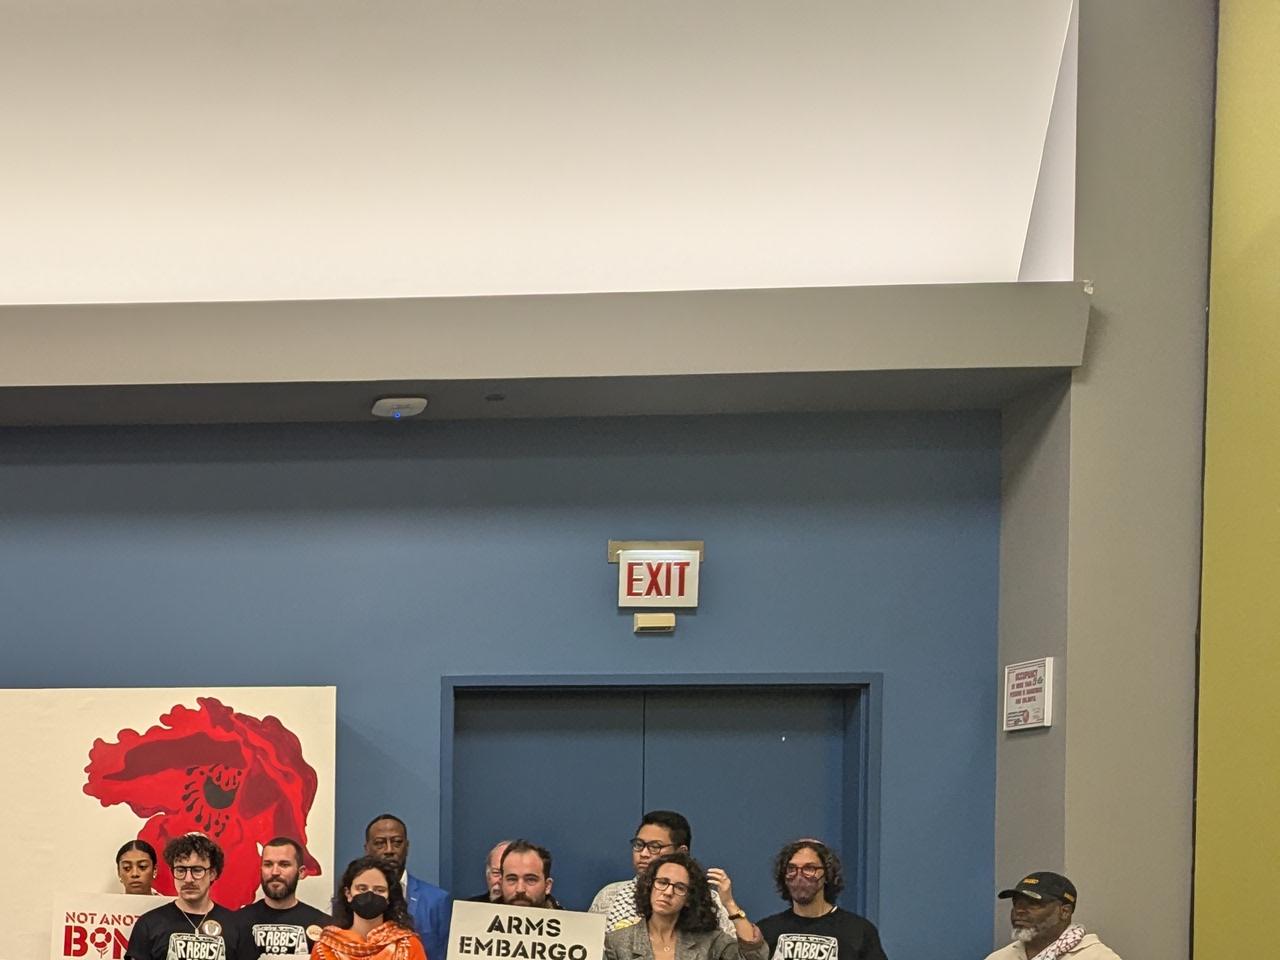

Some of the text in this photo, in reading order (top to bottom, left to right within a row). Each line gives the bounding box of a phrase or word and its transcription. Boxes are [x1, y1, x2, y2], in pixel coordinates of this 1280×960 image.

[626, 561, 690, 597] EXIT
[65, 911, 97, 925] NOT
[487, 915, 561, 937] ARMS
[257, 930, 297, 947] RABBIS
[176, 940, 218, 960] RABBIS
[265, 946, 288, 954] FOR
[784, 941, 829, 960] RABBIS
